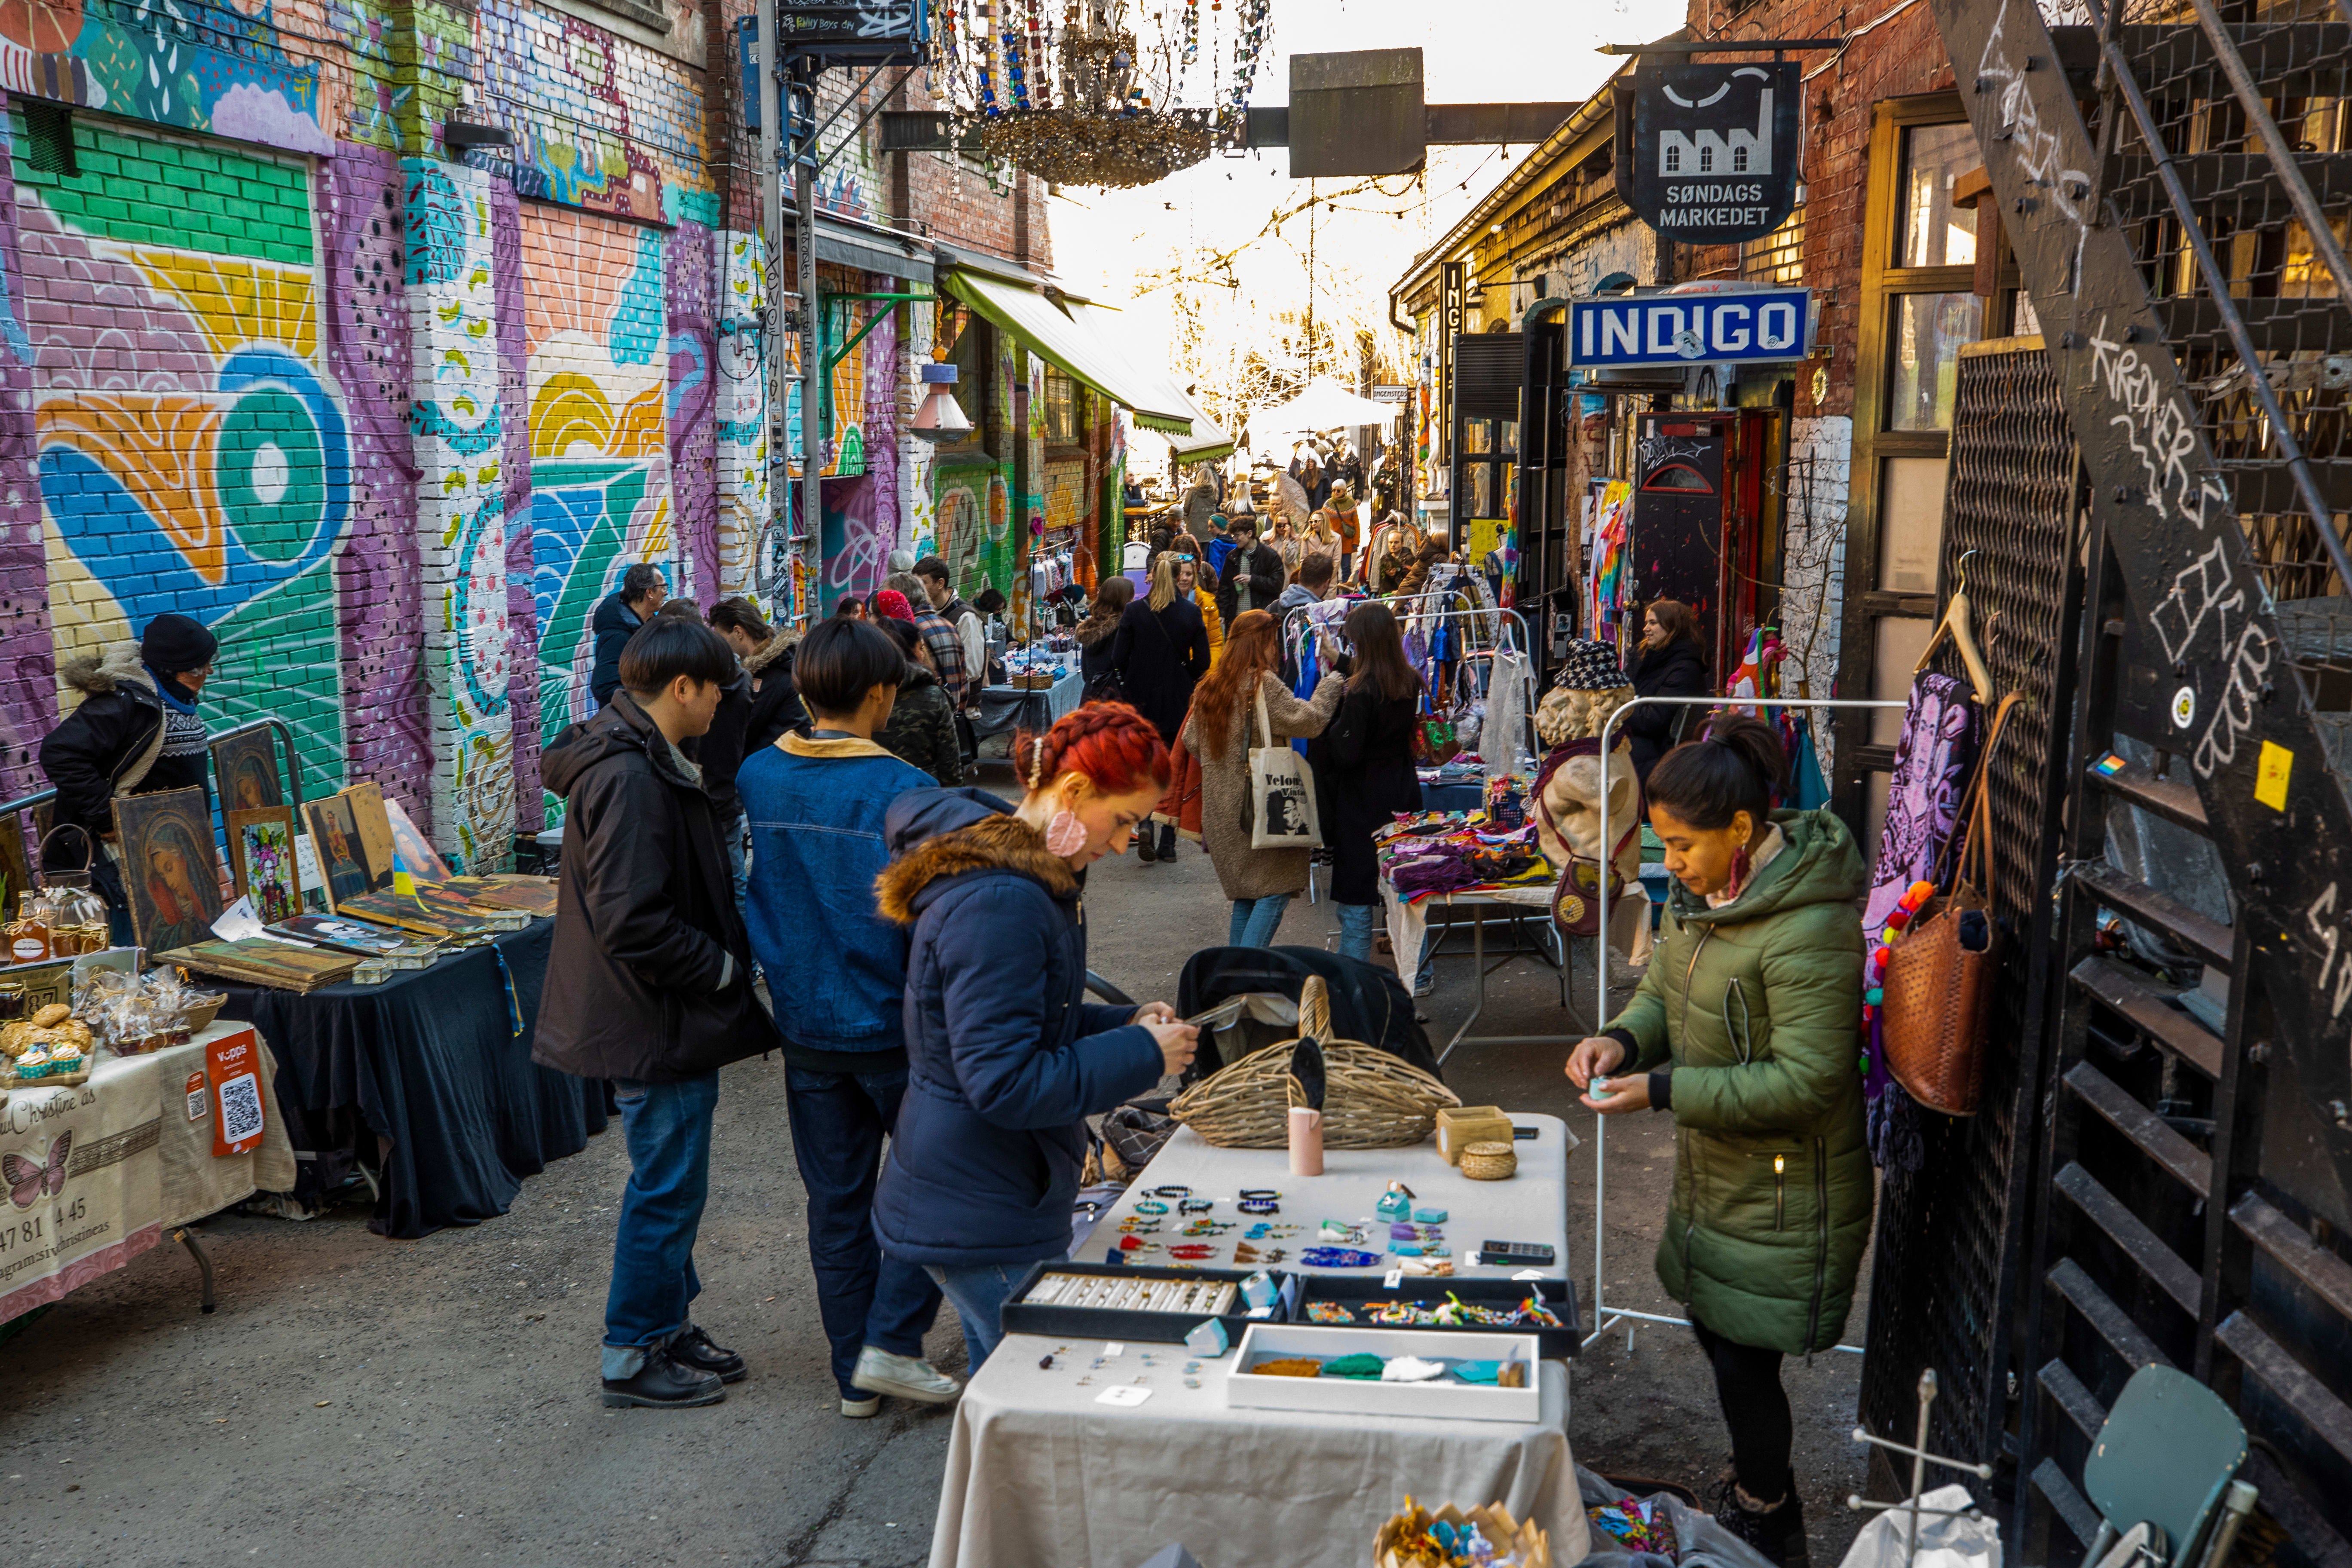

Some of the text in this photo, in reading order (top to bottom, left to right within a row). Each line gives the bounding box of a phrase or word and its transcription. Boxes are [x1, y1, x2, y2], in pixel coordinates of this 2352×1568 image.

[1666, 184, 1762, 203] SØNDAGS
[1660, 207, 1770, 227] MARKEDET
[1582, 302, 1796, 356] INDIGO
[11, 1090, 77, 1134] Christine
[81, 1089, 95, 1106] as
[22, 1217, 43, 1242] 81
[68, 1197, 86, 1221] 45
